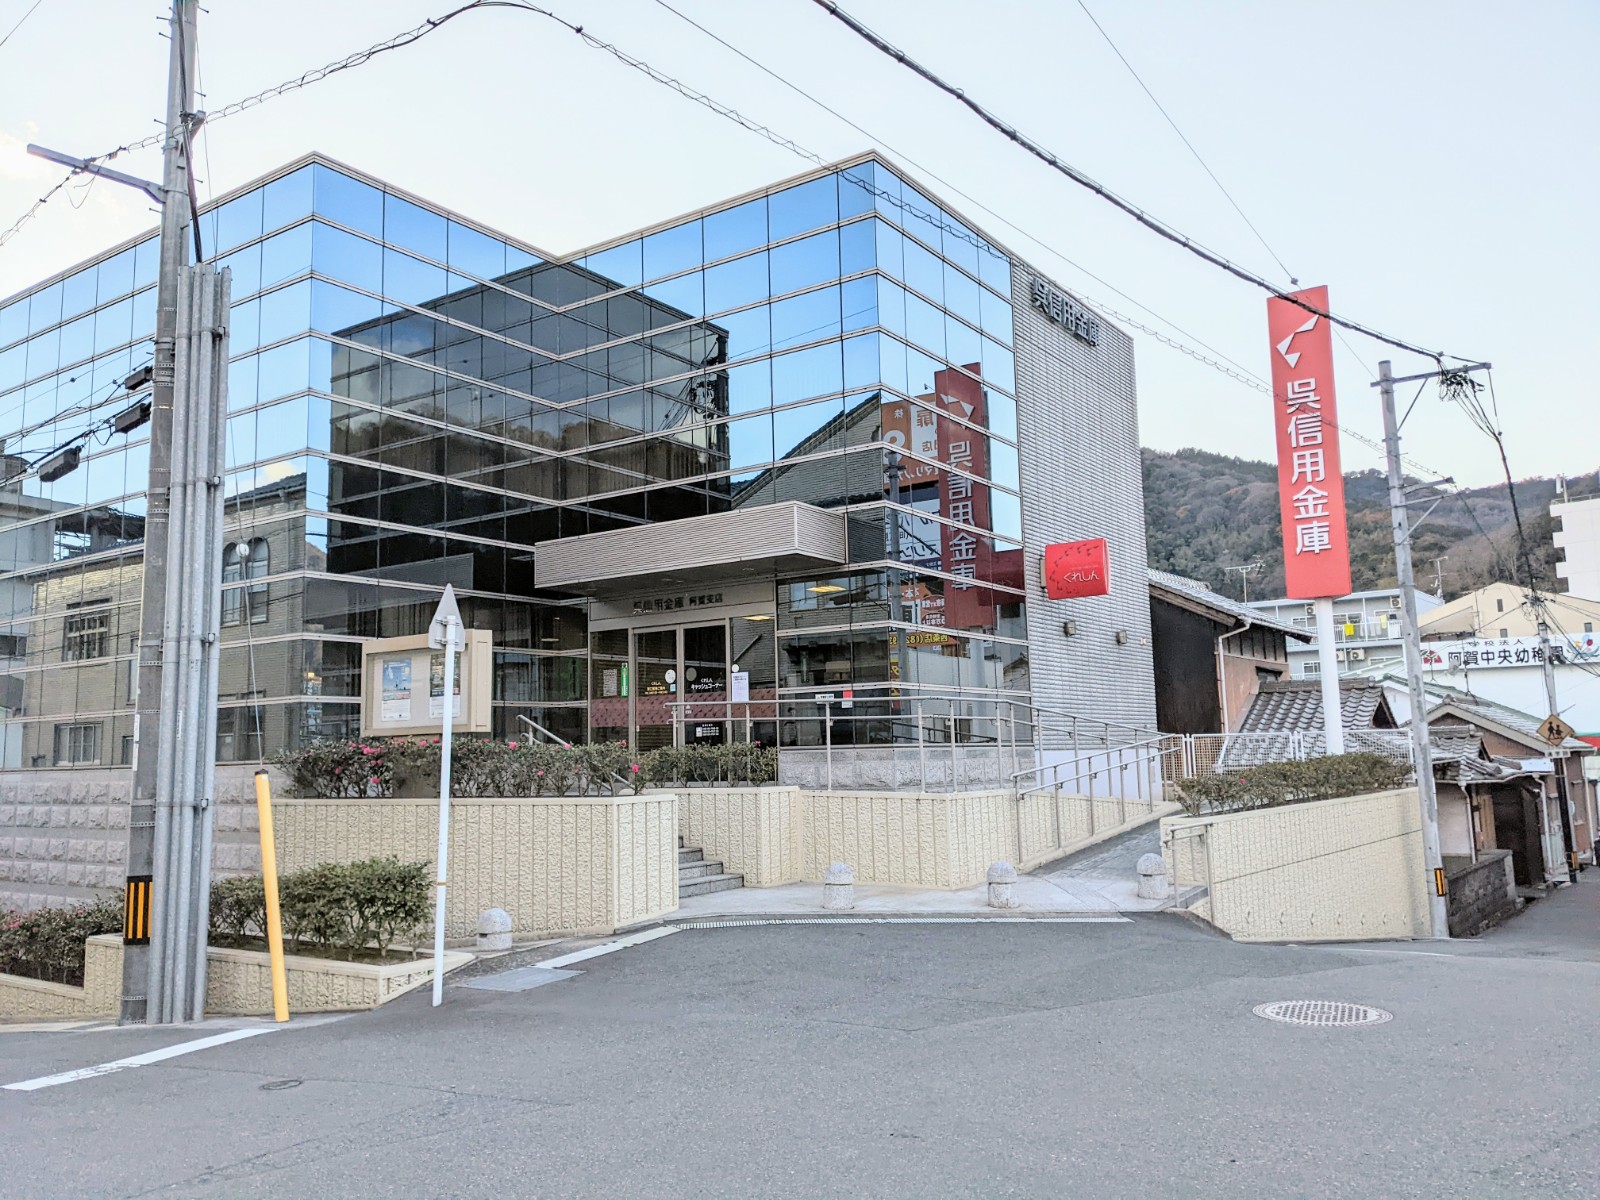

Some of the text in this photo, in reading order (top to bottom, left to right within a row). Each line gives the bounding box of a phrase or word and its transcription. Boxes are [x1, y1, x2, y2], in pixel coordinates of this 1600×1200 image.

[1031, 277, 1100, 348] 呉信用金庫
[1286, 377, 1332, 555] 呉信用金庫
[1063, 570, 1100, 583] くれしん
[1466, 639, 1524, 647] 学校法人
